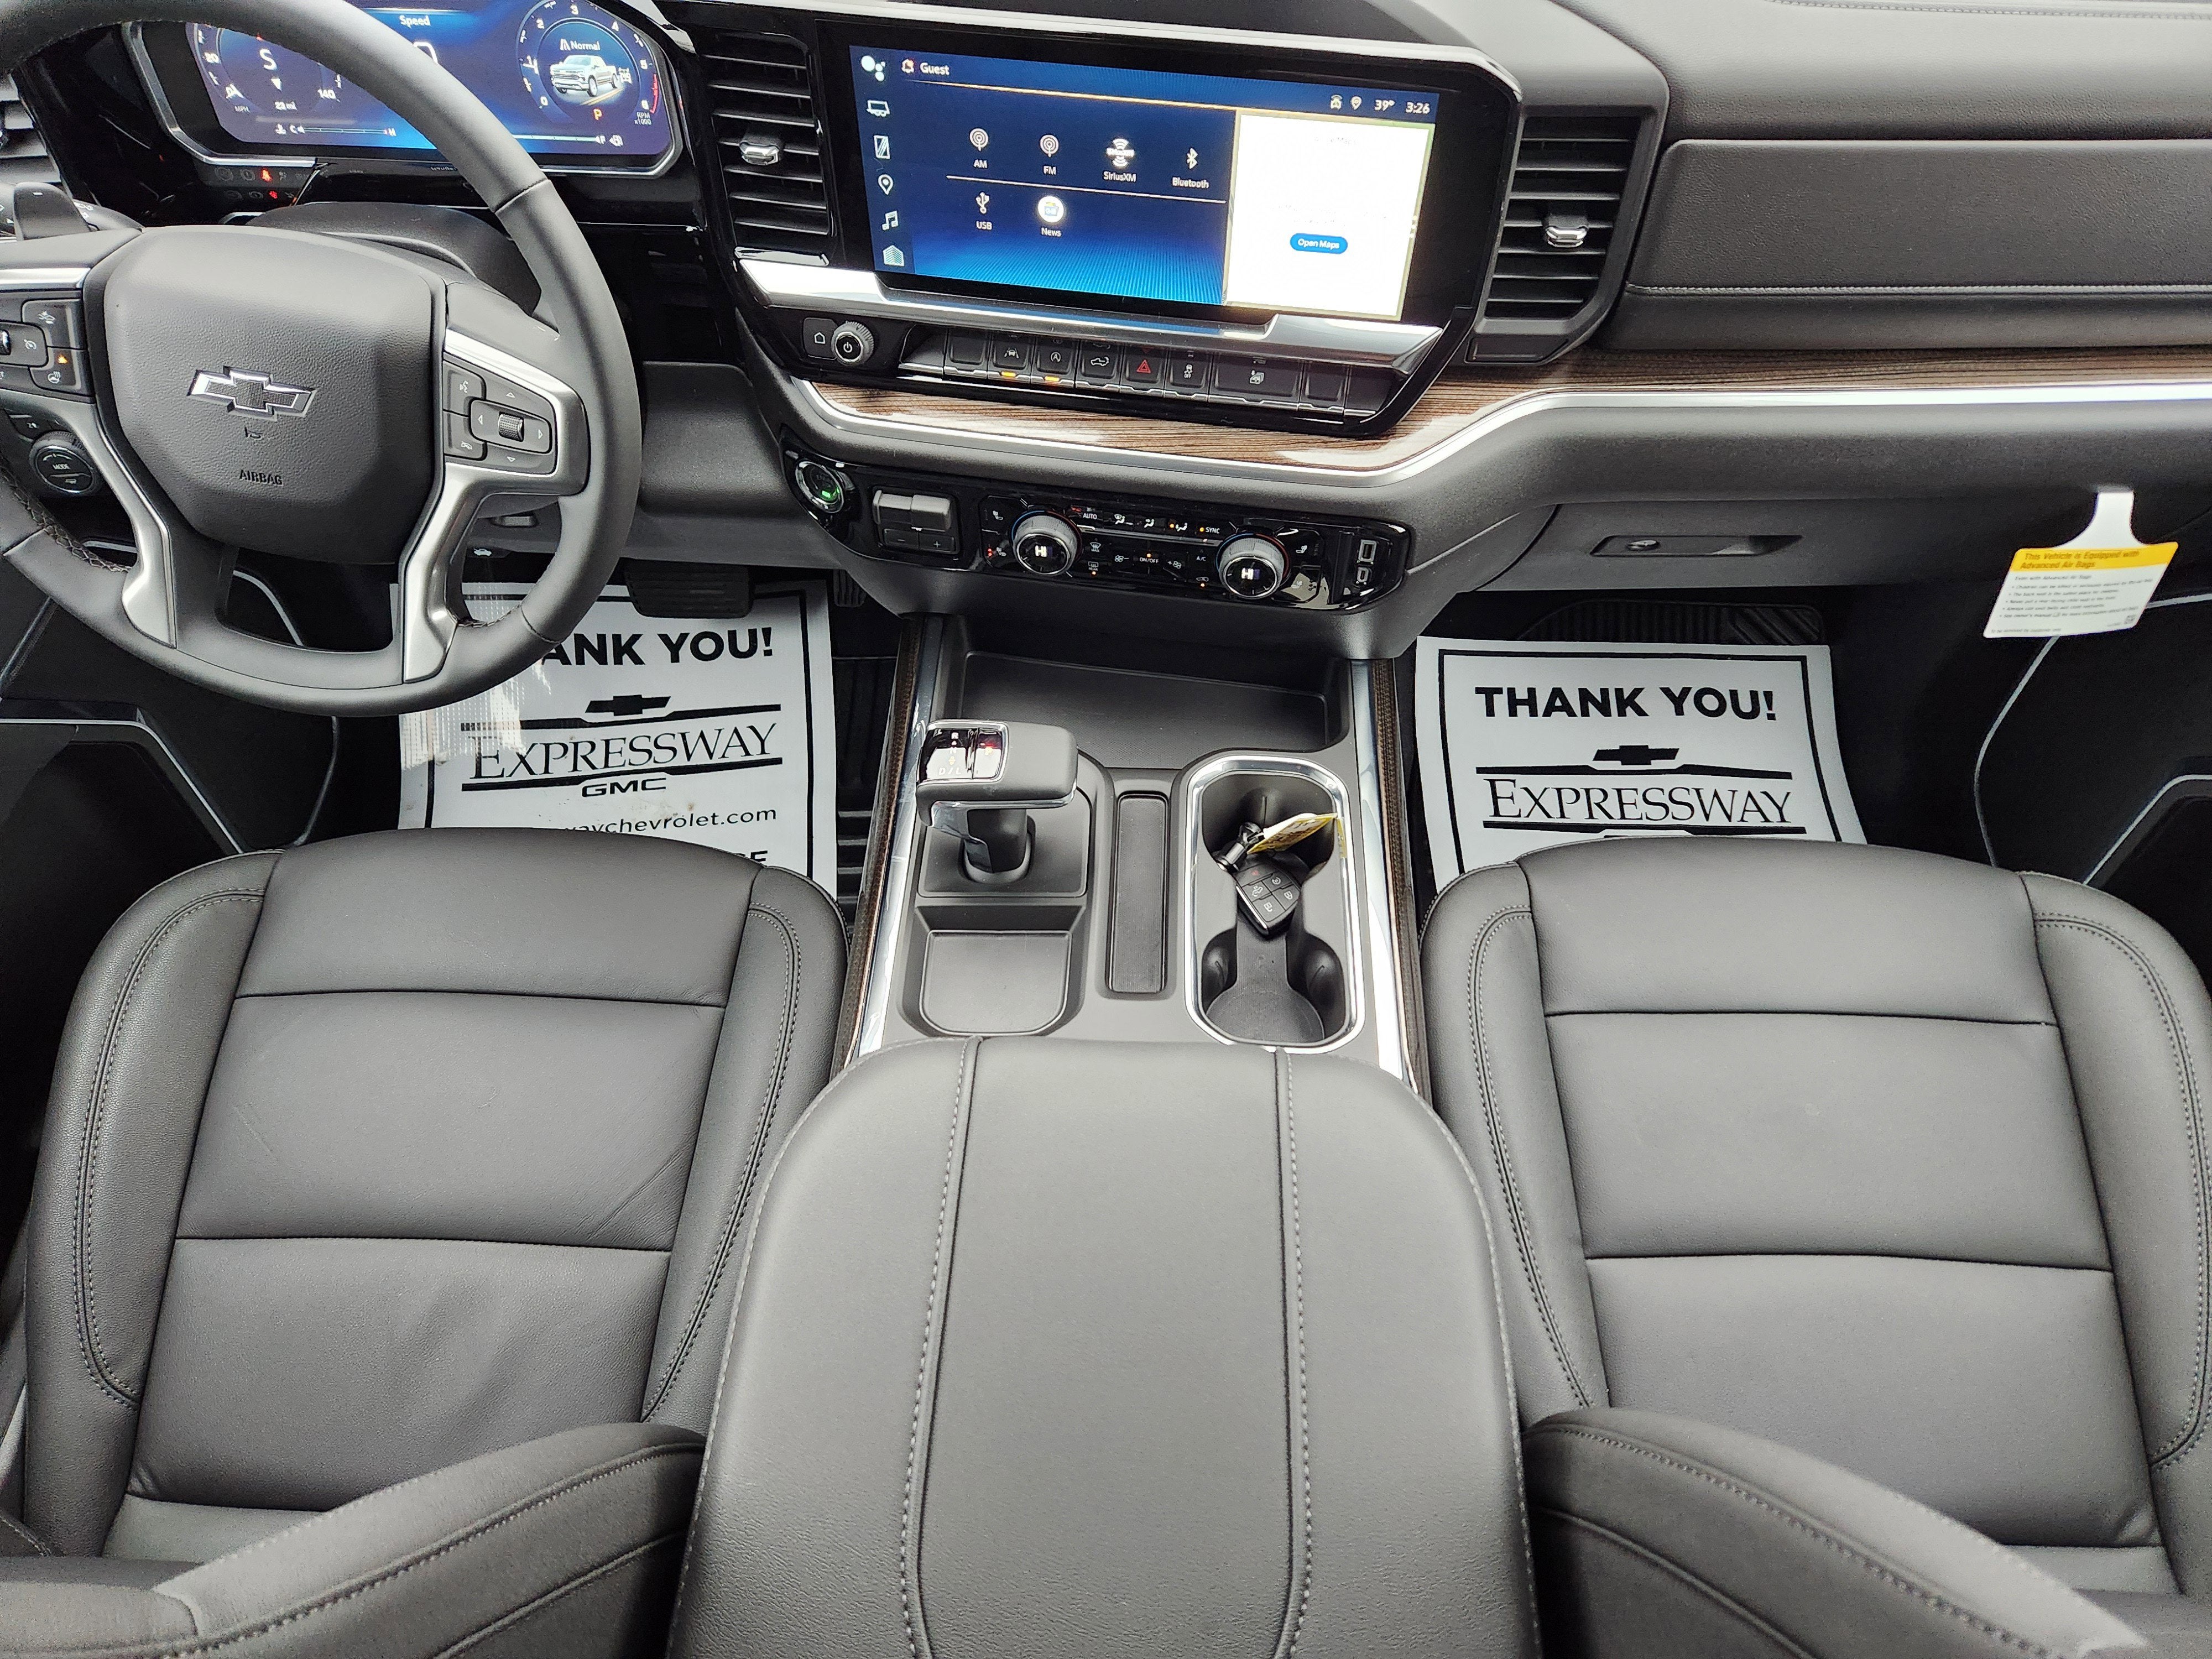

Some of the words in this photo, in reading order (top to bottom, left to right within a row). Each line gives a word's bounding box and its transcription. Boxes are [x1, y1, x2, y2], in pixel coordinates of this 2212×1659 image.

[571, 4, 578, 15] 3
[399, 15, 431, 28] Speed
[537, 18, 544, 29] 2
[570, 40, 601, 51] Normal
[260, 48, 278, 71] S
[919, 61, 950, 76] Guest
[317, 89, 337, 100] 140
[234, 105, 251, 113] MPH
[1405, 101, 1431, 115] 3:26
[593, 108, 602, 121] P
[388, 127, 397, 137] H
[973, 159, 988, 169] AM
[1043, 165, 1057, 175] FM
[1103, 170, 1137, 183] SiriusXM
[1172, 177, 1210, 189] Bluetooth
[975, 221, 993, 231] USB
[1041, 227, 1062, 237] News
[1297, 238, 1319, 248] Open
[1319, 239, 1340, 251] Maps
[239, 469, 284, 486] AIRBAG
[1083, 512, 1098, 520] AUTO
[1205, 526, 1220, 535] SYNC
[542, 633, 646, 666] ANK
[658, 627, 773, 664] YOU!
[1475, 686, 1650, 718] THANK
[1661, 687, 1777, 721] YOU!
[581, 778, 666, 798] GMC
